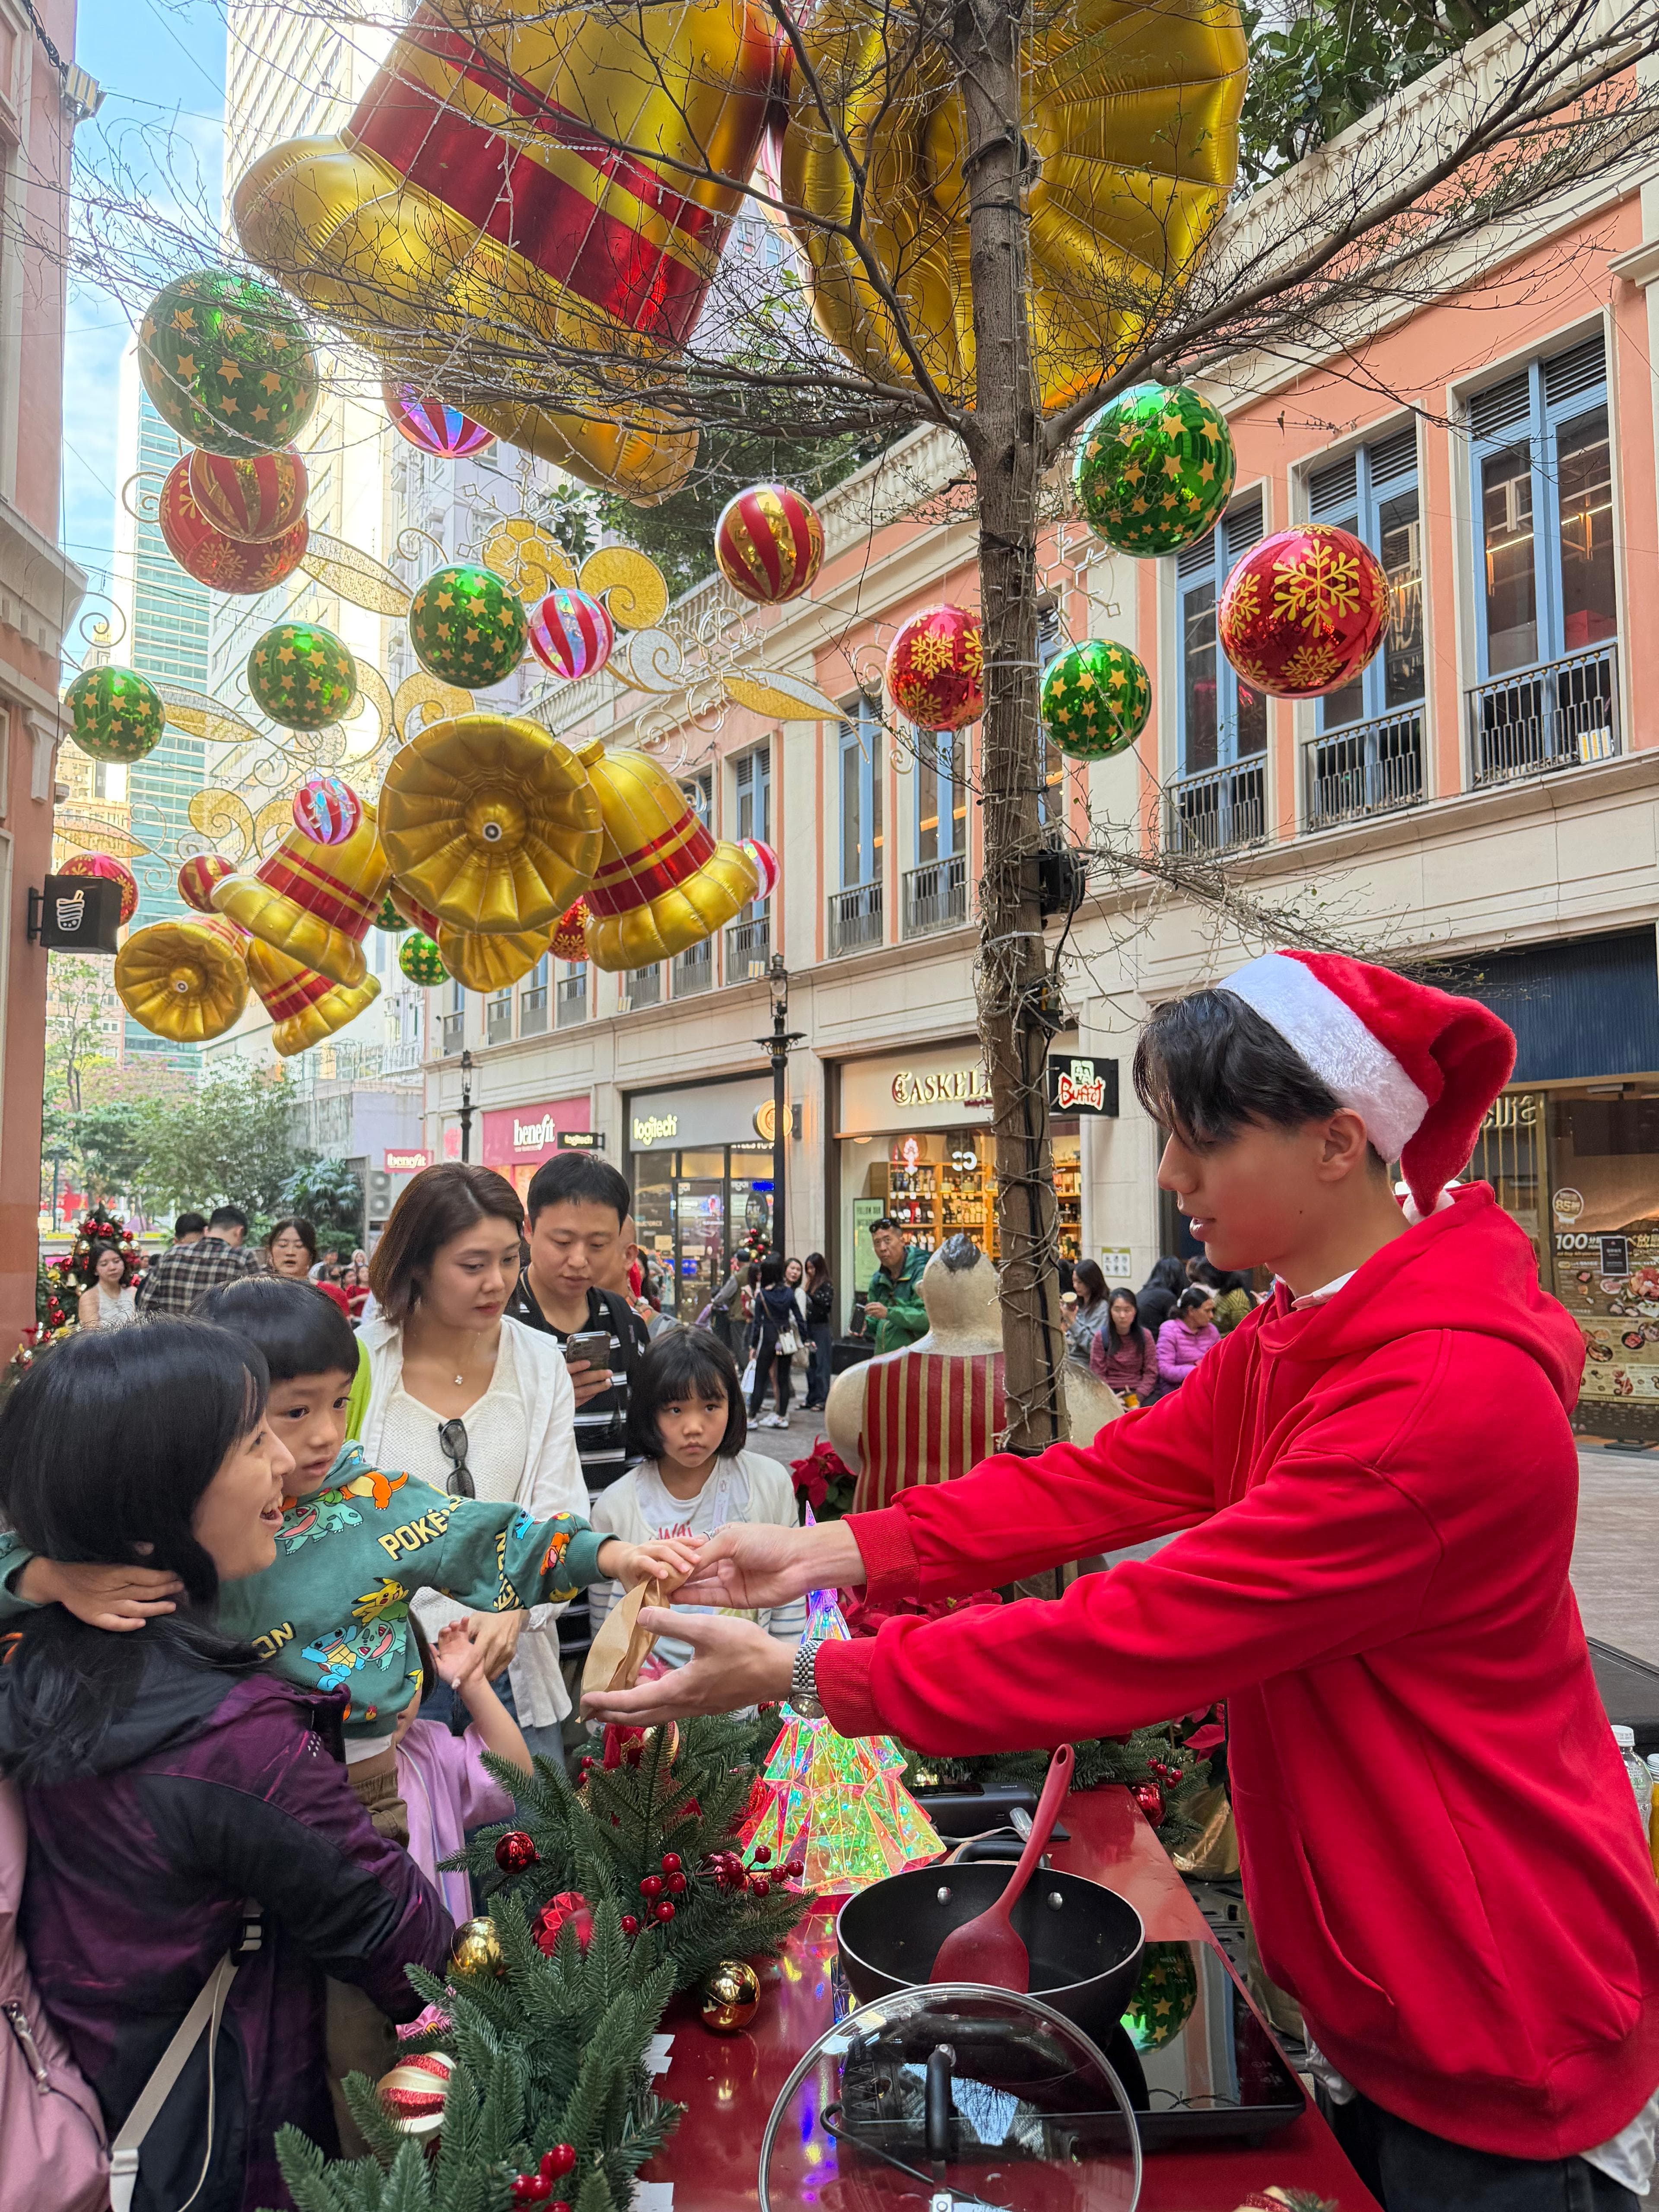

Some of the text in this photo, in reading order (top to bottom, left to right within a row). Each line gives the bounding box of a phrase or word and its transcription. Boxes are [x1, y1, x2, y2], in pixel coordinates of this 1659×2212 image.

[1060, 1074, 1105, 1109] Buffet
[513, 1113, 555, 1150] benefit
[564, 1135, 593, 1146] logitech
[633, 1114, 678, 1145] logitech
[387, 1153, 426, 1169] benefit
